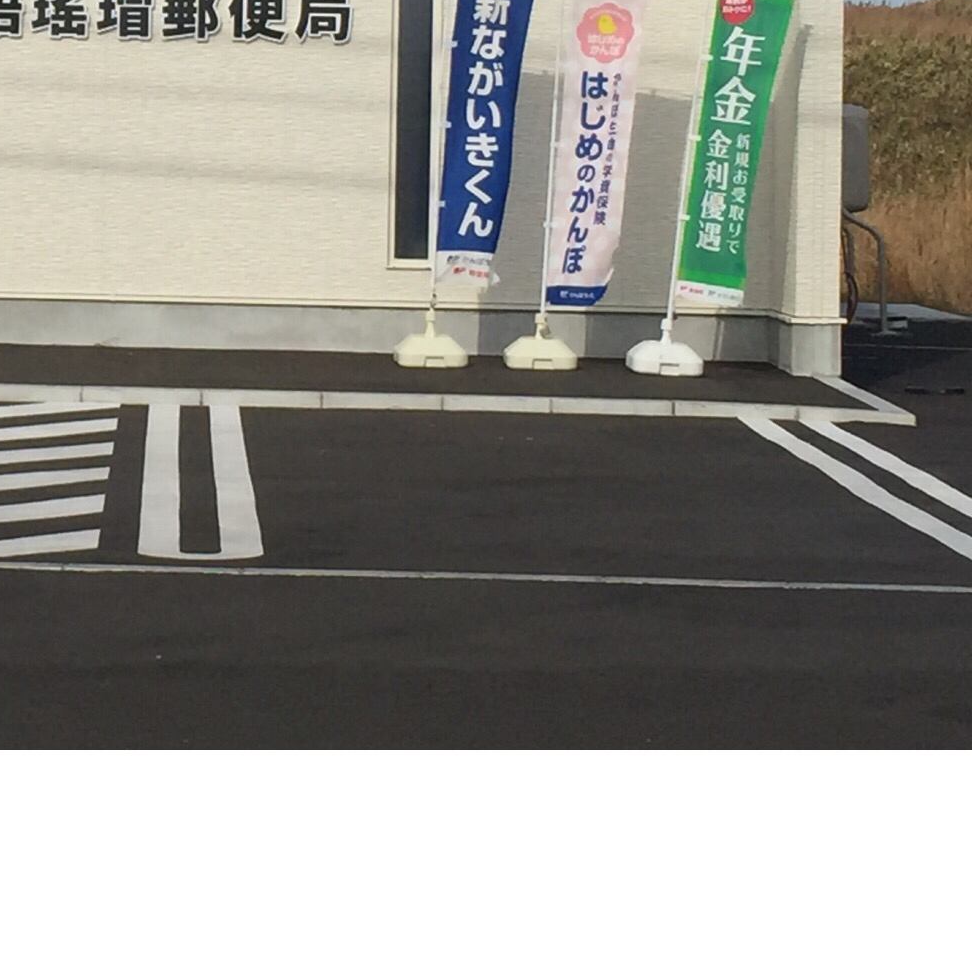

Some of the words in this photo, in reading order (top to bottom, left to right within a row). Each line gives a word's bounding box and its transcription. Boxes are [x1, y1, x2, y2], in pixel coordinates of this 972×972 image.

[711, 26, 766, 126] 年金
[562, 71, 608, 274] はじめのかんぽ
[695, 129, 732, 253] 金利優遇
[726, 133, 750, 254] 新規お受取りで
